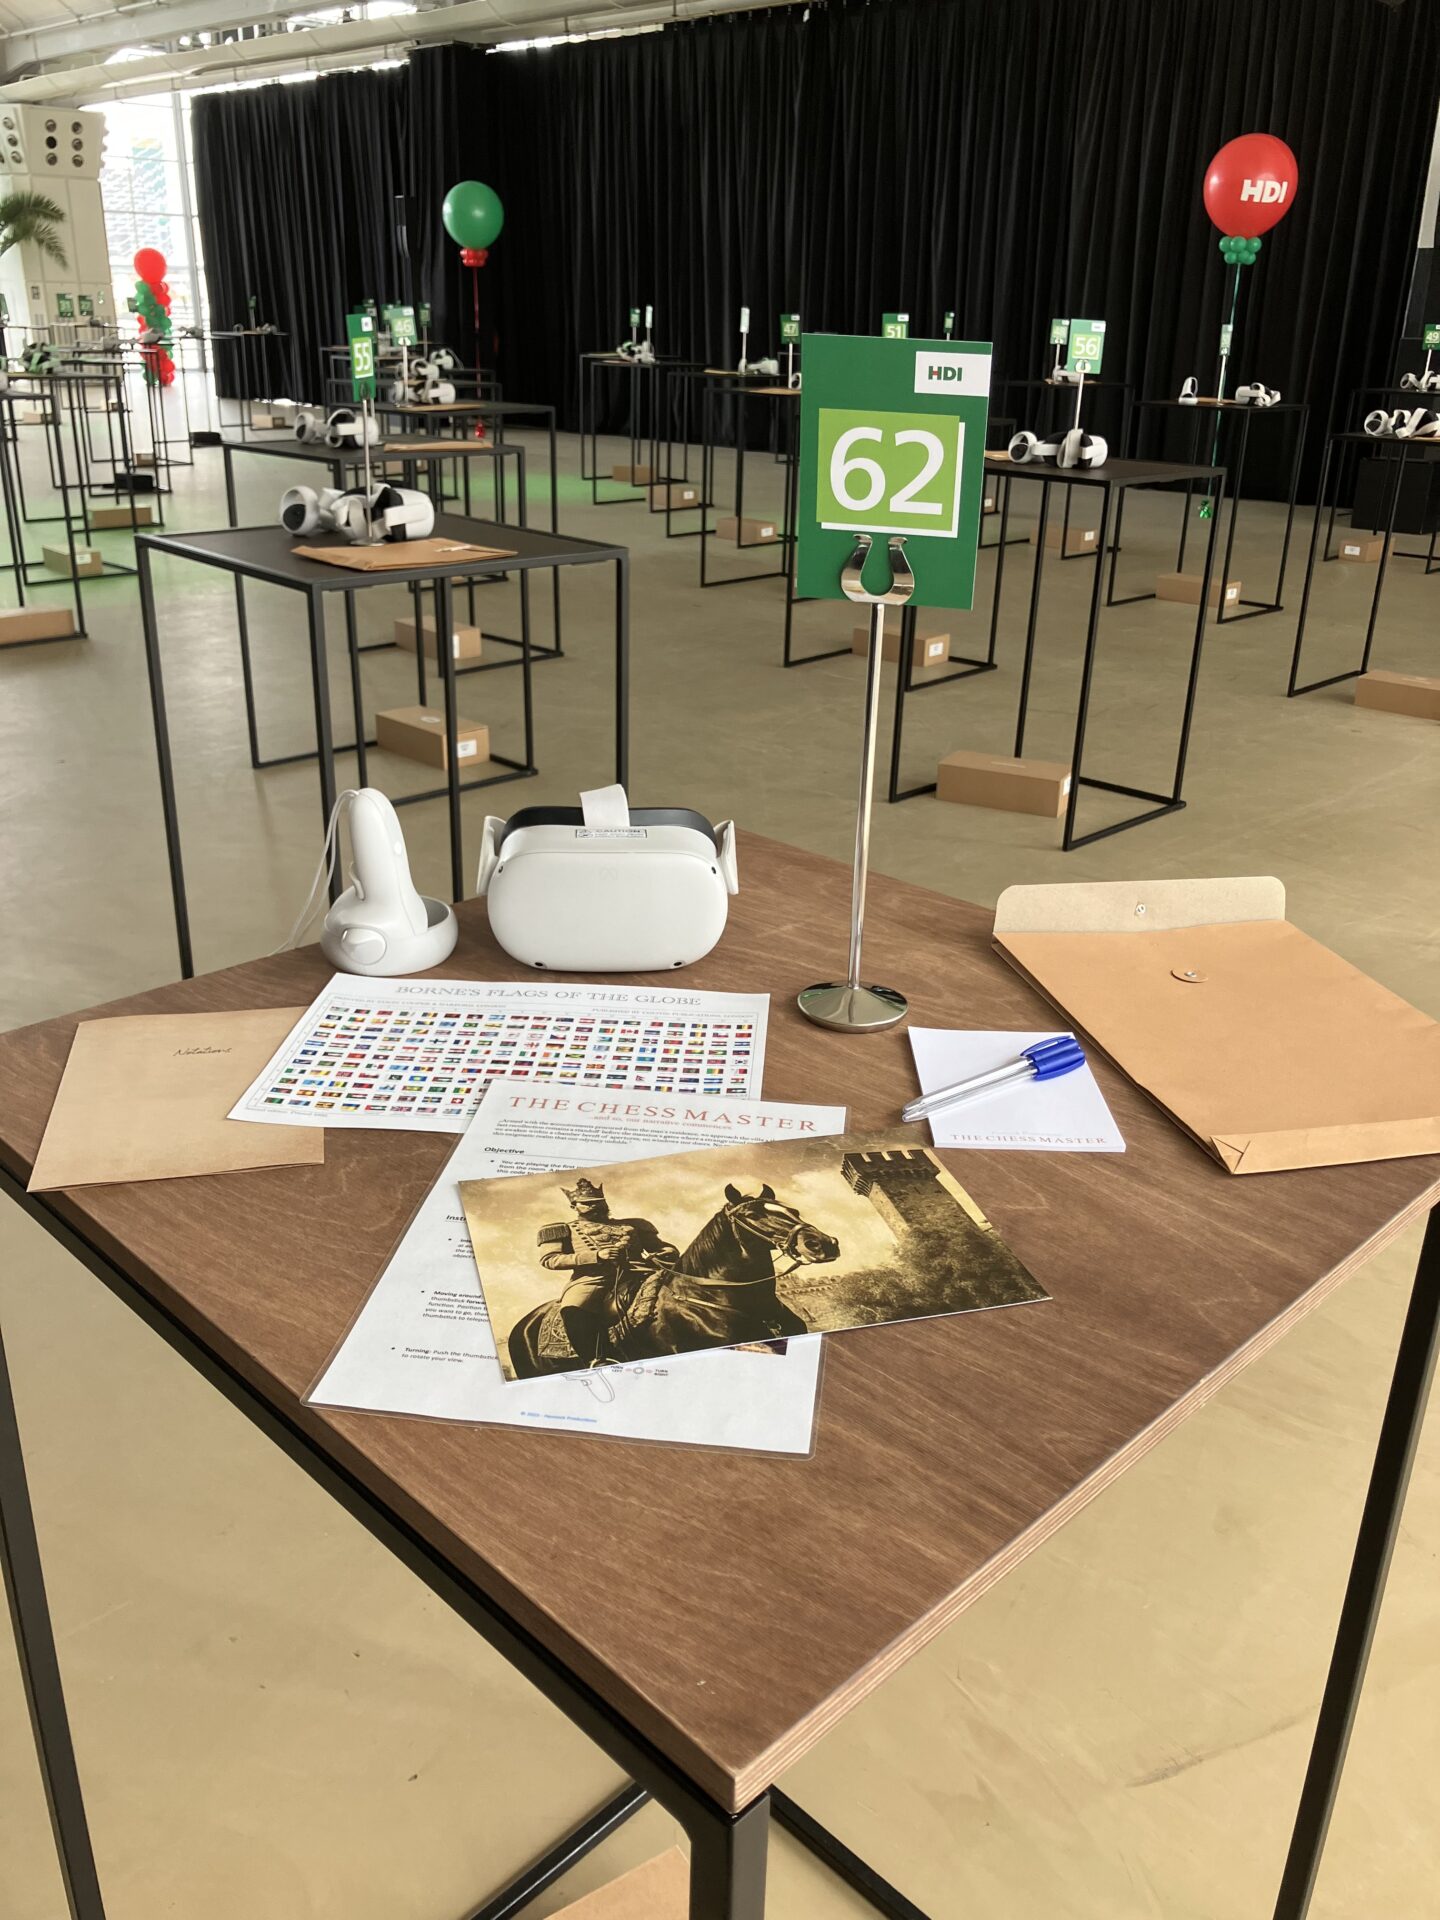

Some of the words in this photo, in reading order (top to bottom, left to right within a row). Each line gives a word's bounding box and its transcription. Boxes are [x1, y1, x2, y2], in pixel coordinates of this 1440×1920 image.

[1240, 179, 1289, 203] HDI
[352, 341, 371, 372] 55
[1075, 336, 1098, 356] 56
[928, 365, 962, 381] HDI
[829, 427, 945, 516] 62
[398, 986, 481, 996] BORNE'S
[487, 989, 548, 998] FLAGS
[555, 991, 583, 999] OF
[588, 992, 629, 1001] THE
[635, 995, 701, 1006] GLOBE
[510, 1096, 571, 1111] THE
[577, 1101, 676, 1119] CHESS
[684, 1109, 817, 1132] MASTER
[1038, 1136, 1107, 1144] MASTER
